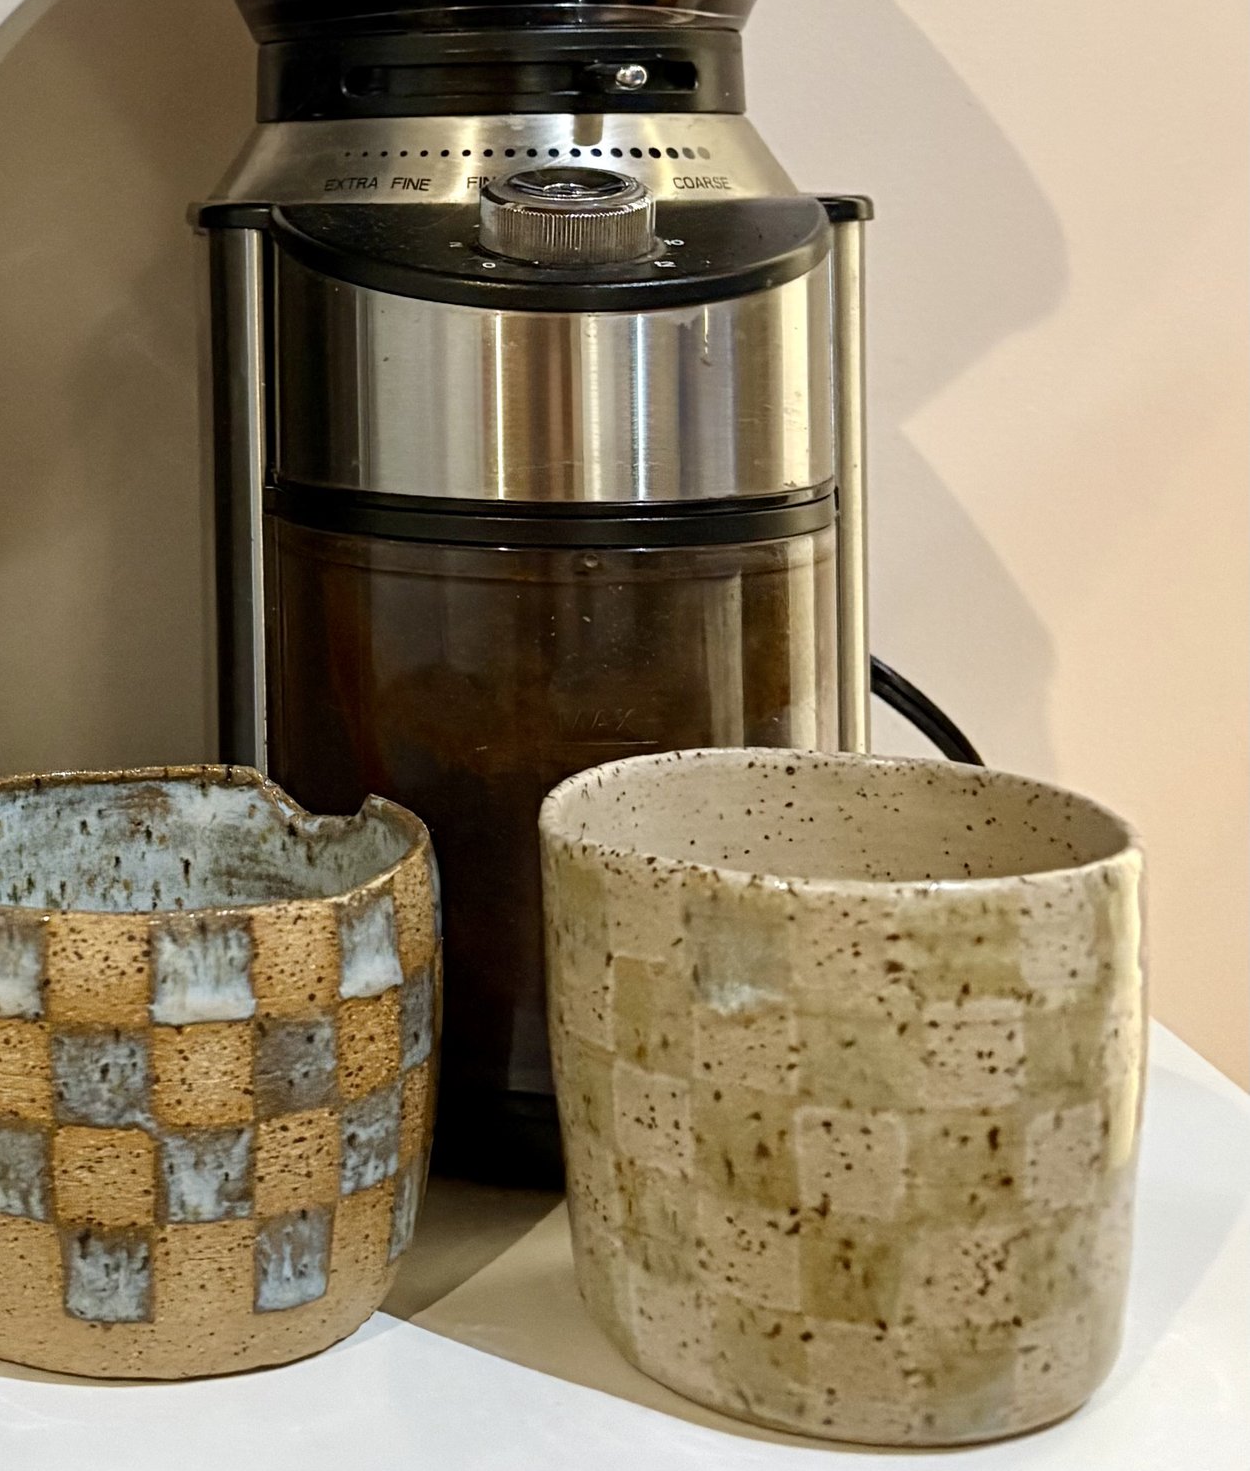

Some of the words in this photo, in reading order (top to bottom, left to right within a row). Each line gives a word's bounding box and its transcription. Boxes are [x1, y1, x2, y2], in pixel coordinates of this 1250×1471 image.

[324, 176, 378, 191] EXTRA
[391, 176, 432, 191] FINE
[673, 176, 732, 190] COARSE
